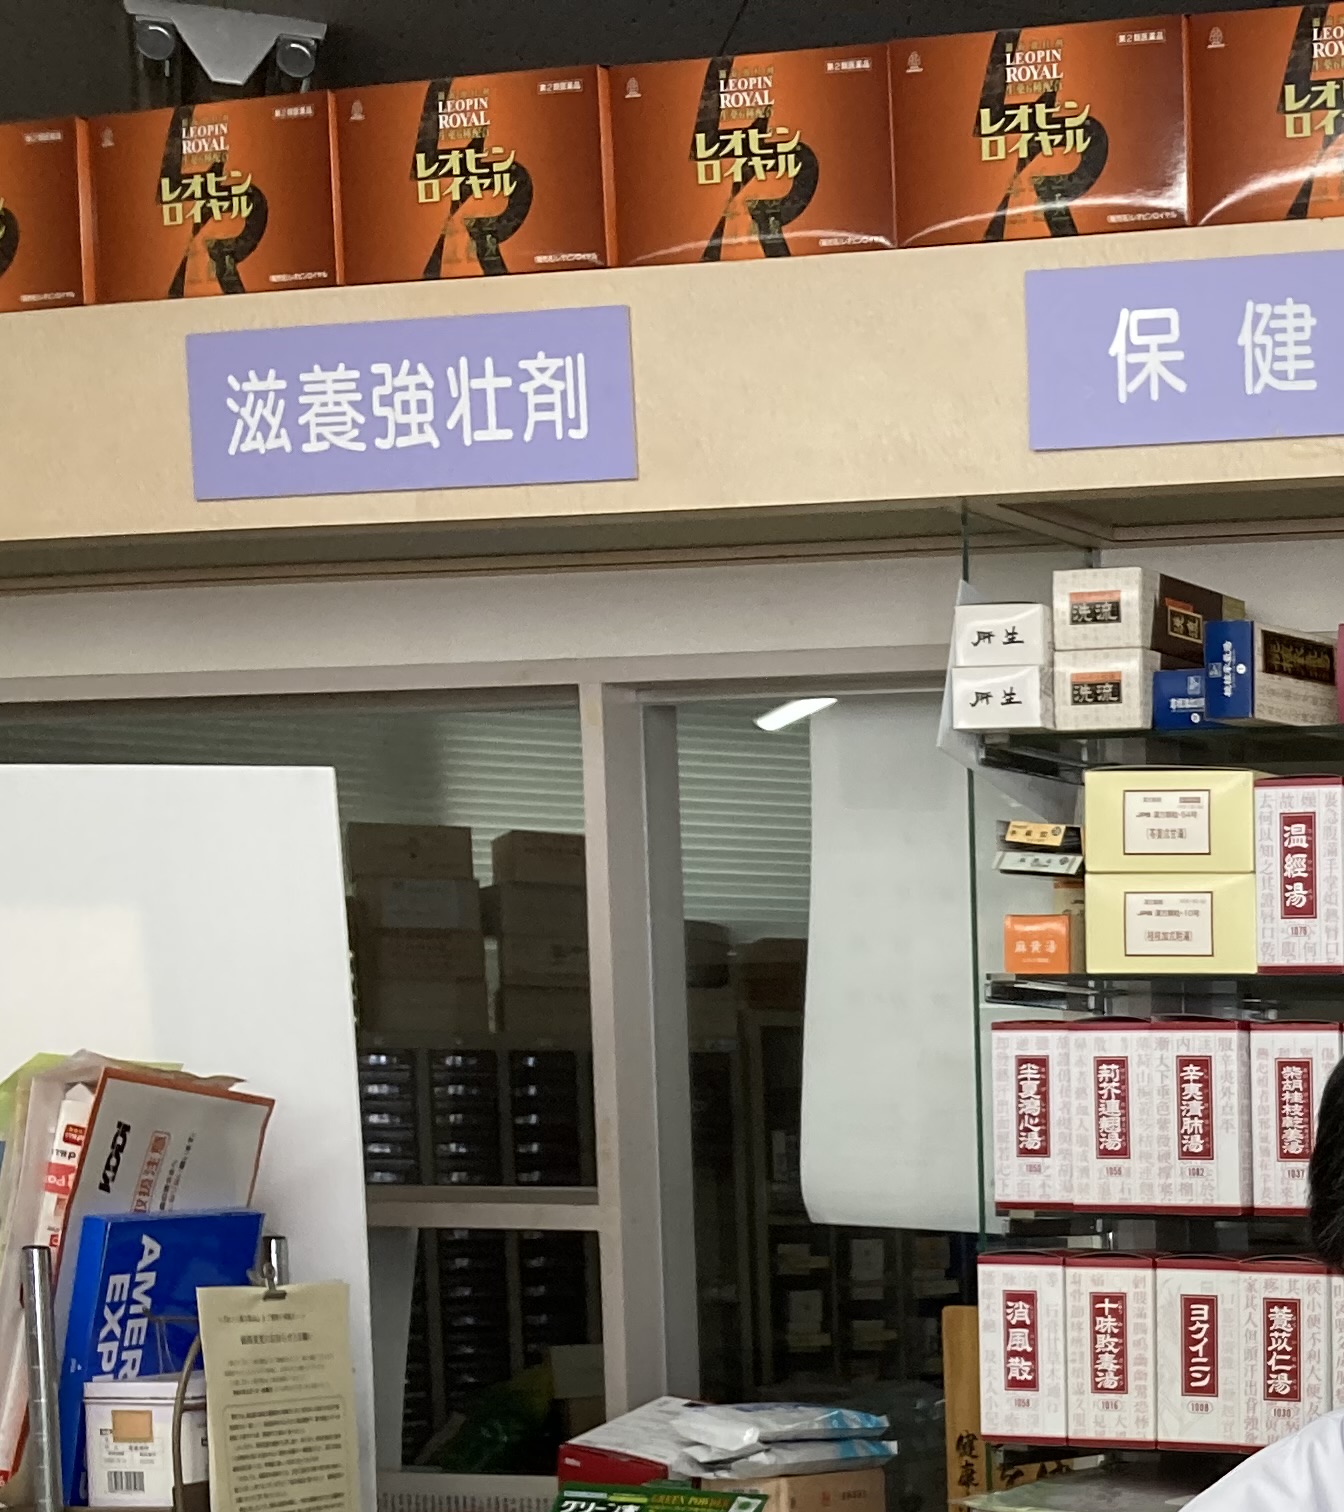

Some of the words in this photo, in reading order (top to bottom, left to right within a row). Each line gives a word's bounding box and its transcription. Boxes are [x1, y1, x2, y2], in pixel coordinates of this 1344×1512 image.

[1005, 49, 1062, 66] LEOPIN
[719, 75, 773, 92] LEOPIN
[1005, 63, 1064, 83] ROYAL
[438, 96, 489, 113] LEOPIN
[719, 90, 775, 109] ROYAL
[182, 123, 229, 139] LEOPIN
[438, 111, 491, 129] ROYAL
[182, 138, 230, 154] ROYAL
[981, 129, 1091, 161] ロイヤル
[696, 153, 802, 185] ロイヤル
[417, 173, 517, 203] ロイヤル
[162, 199, 253, 226] ロイヤル
[226, 351, 588, 456] 滋養強壮剤
[1006, 1300, 1033, 1382] 消風散
[1094, 1298, 1121, 1389] 十味敗毒湯
[1189, 1303, 1212, 1388] ヨクイニン
